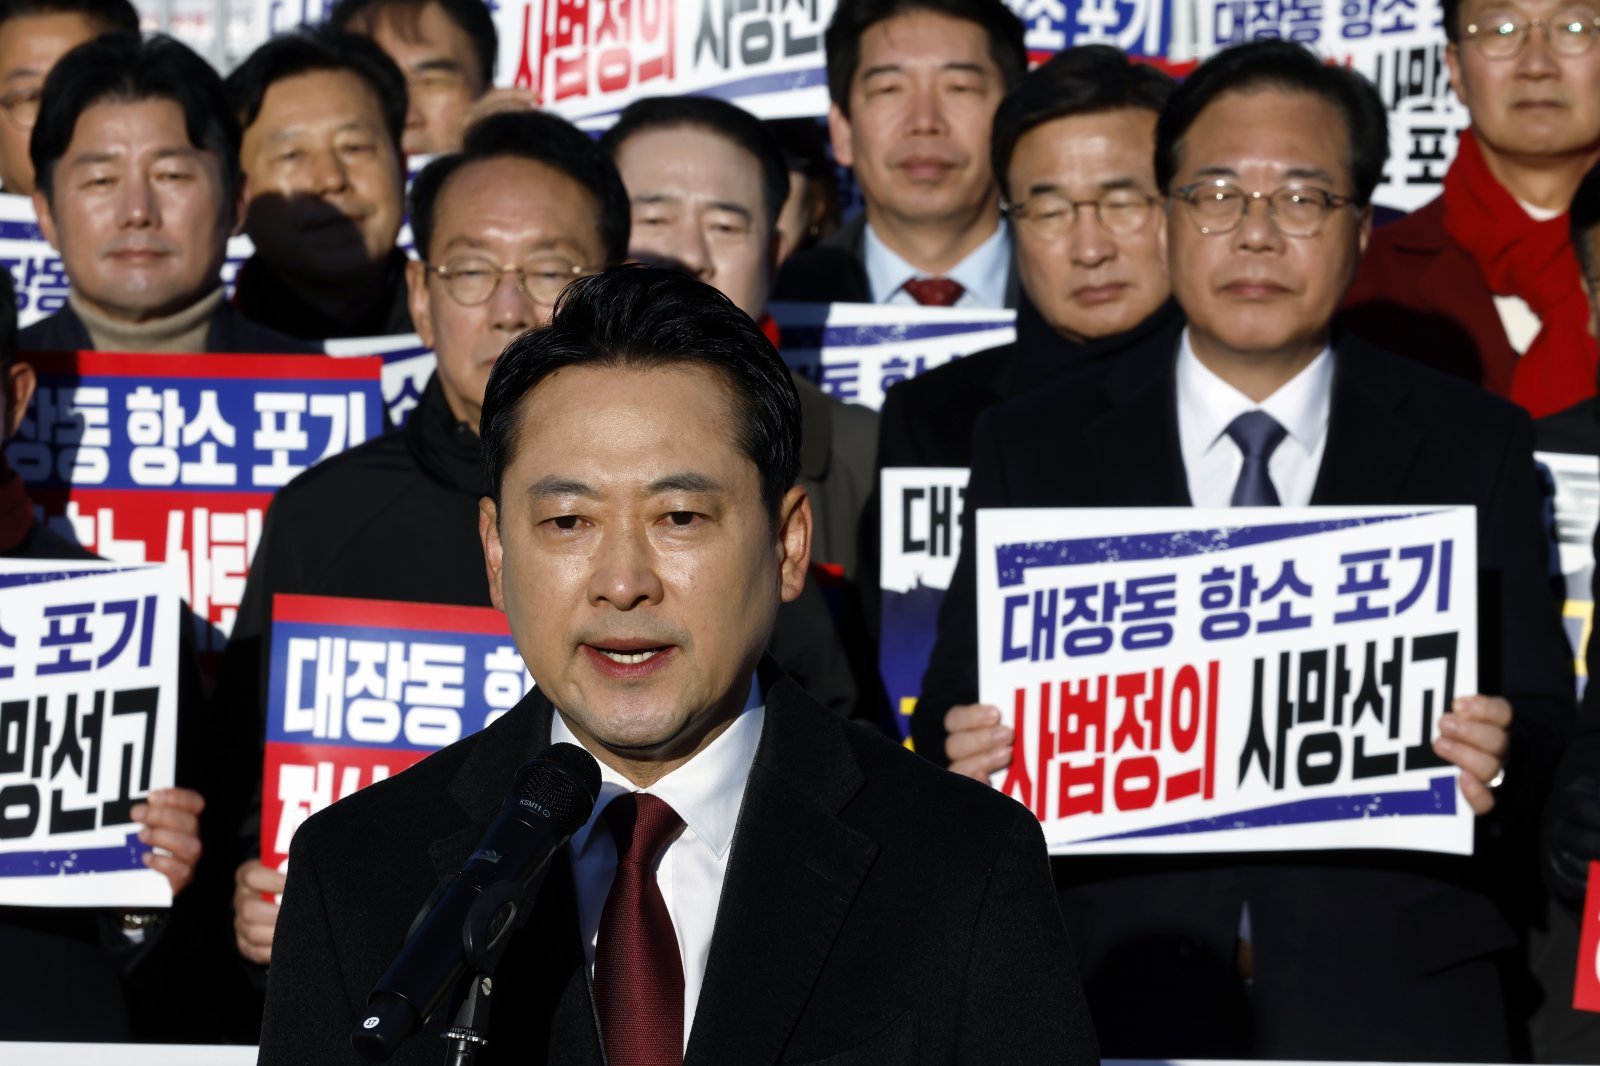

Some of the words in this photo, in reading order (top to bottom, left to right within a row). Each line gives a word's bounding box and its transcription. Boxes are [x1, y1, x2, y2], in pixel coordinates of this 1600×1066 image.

[693, 0, 822, 70] 사망선
[1341, 0, 1417, 39] 항소
[126, 386, 238, 486] 항소
[252, 391, 367, 487] 포기
[35, 595, 158, 677] 포기
[1000, 573, 1177, 663] 대장동
[1200, 559, 1313, 641] 항소
[1333, 538, 1454, 625] 포기
[284, 636, 466, 747] 대장동
[1001, 659, 1220, 823] 사법정의
[1238, 631, 1459, 791] 사망선고
[519, 799, 542, 811] KSM11
